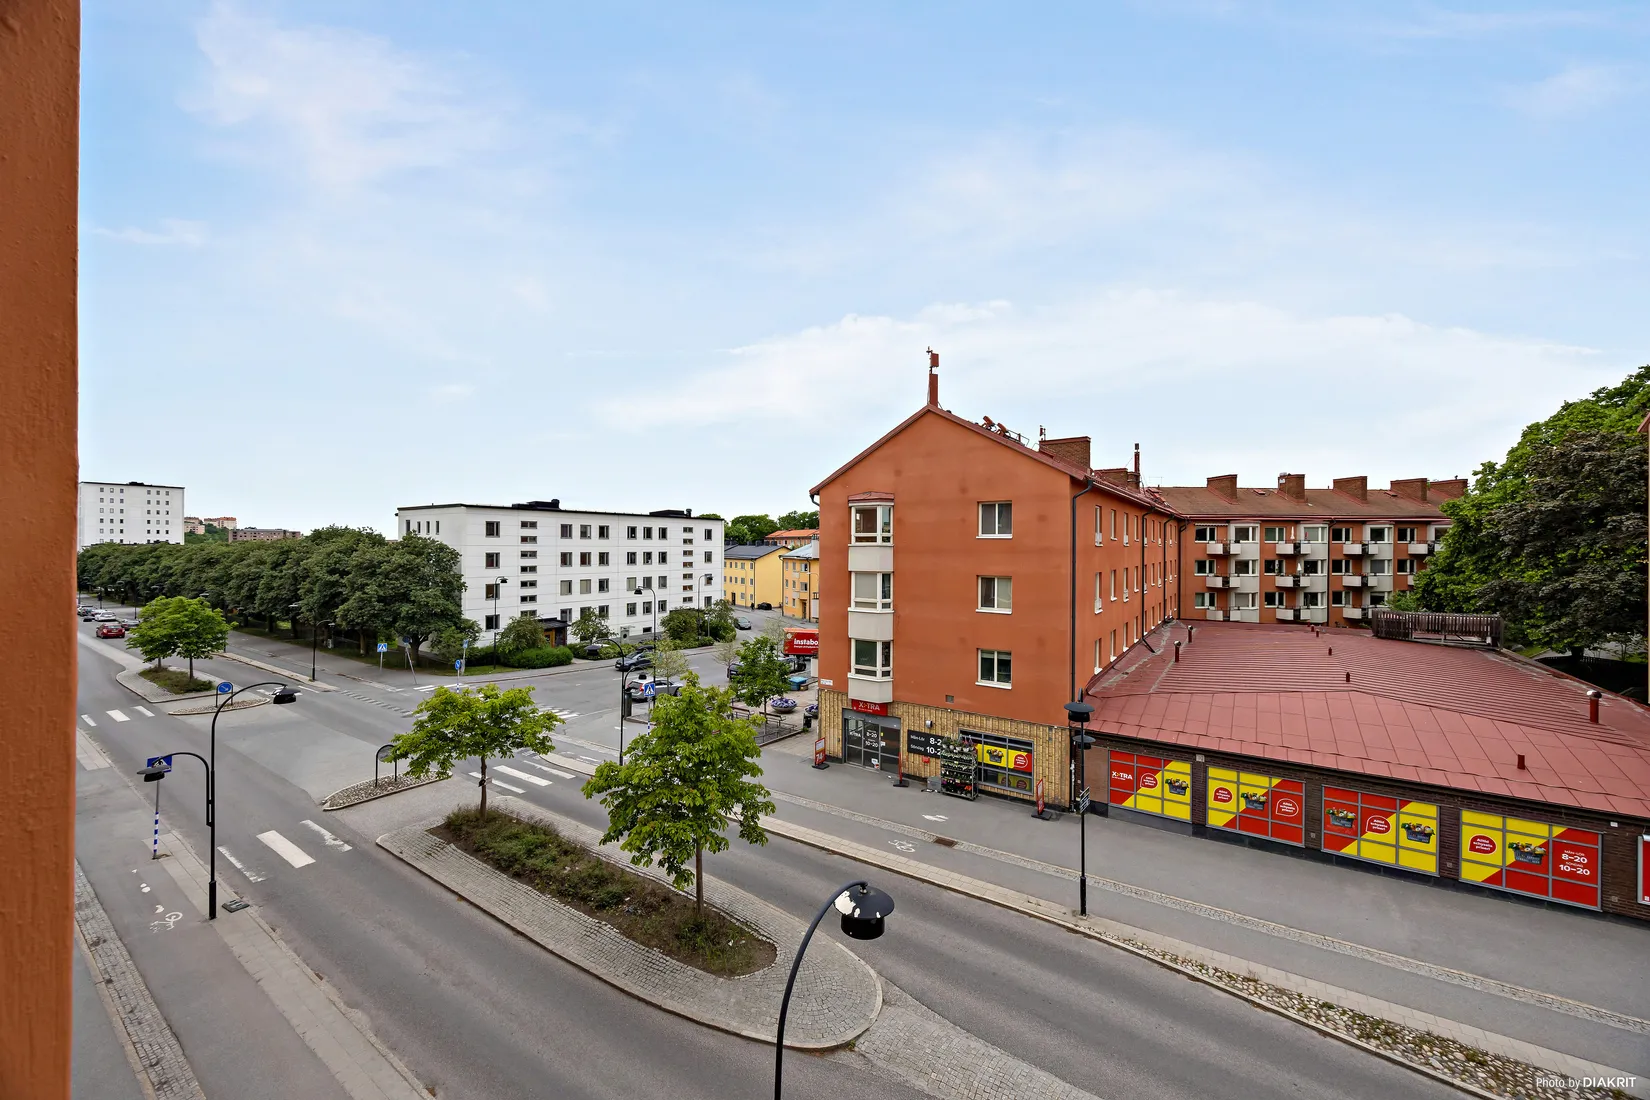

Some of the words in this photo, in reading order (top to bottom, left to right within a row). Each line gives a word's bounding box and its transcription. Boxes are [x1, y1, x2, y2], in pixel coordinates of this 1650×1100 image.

[929, 737, 942, 745] 8-2
[926, 746, 941, 755] 10-2
[1562, 853, 1588, 863] 8-20
[1559, 864, 1590, 876] 10-20
